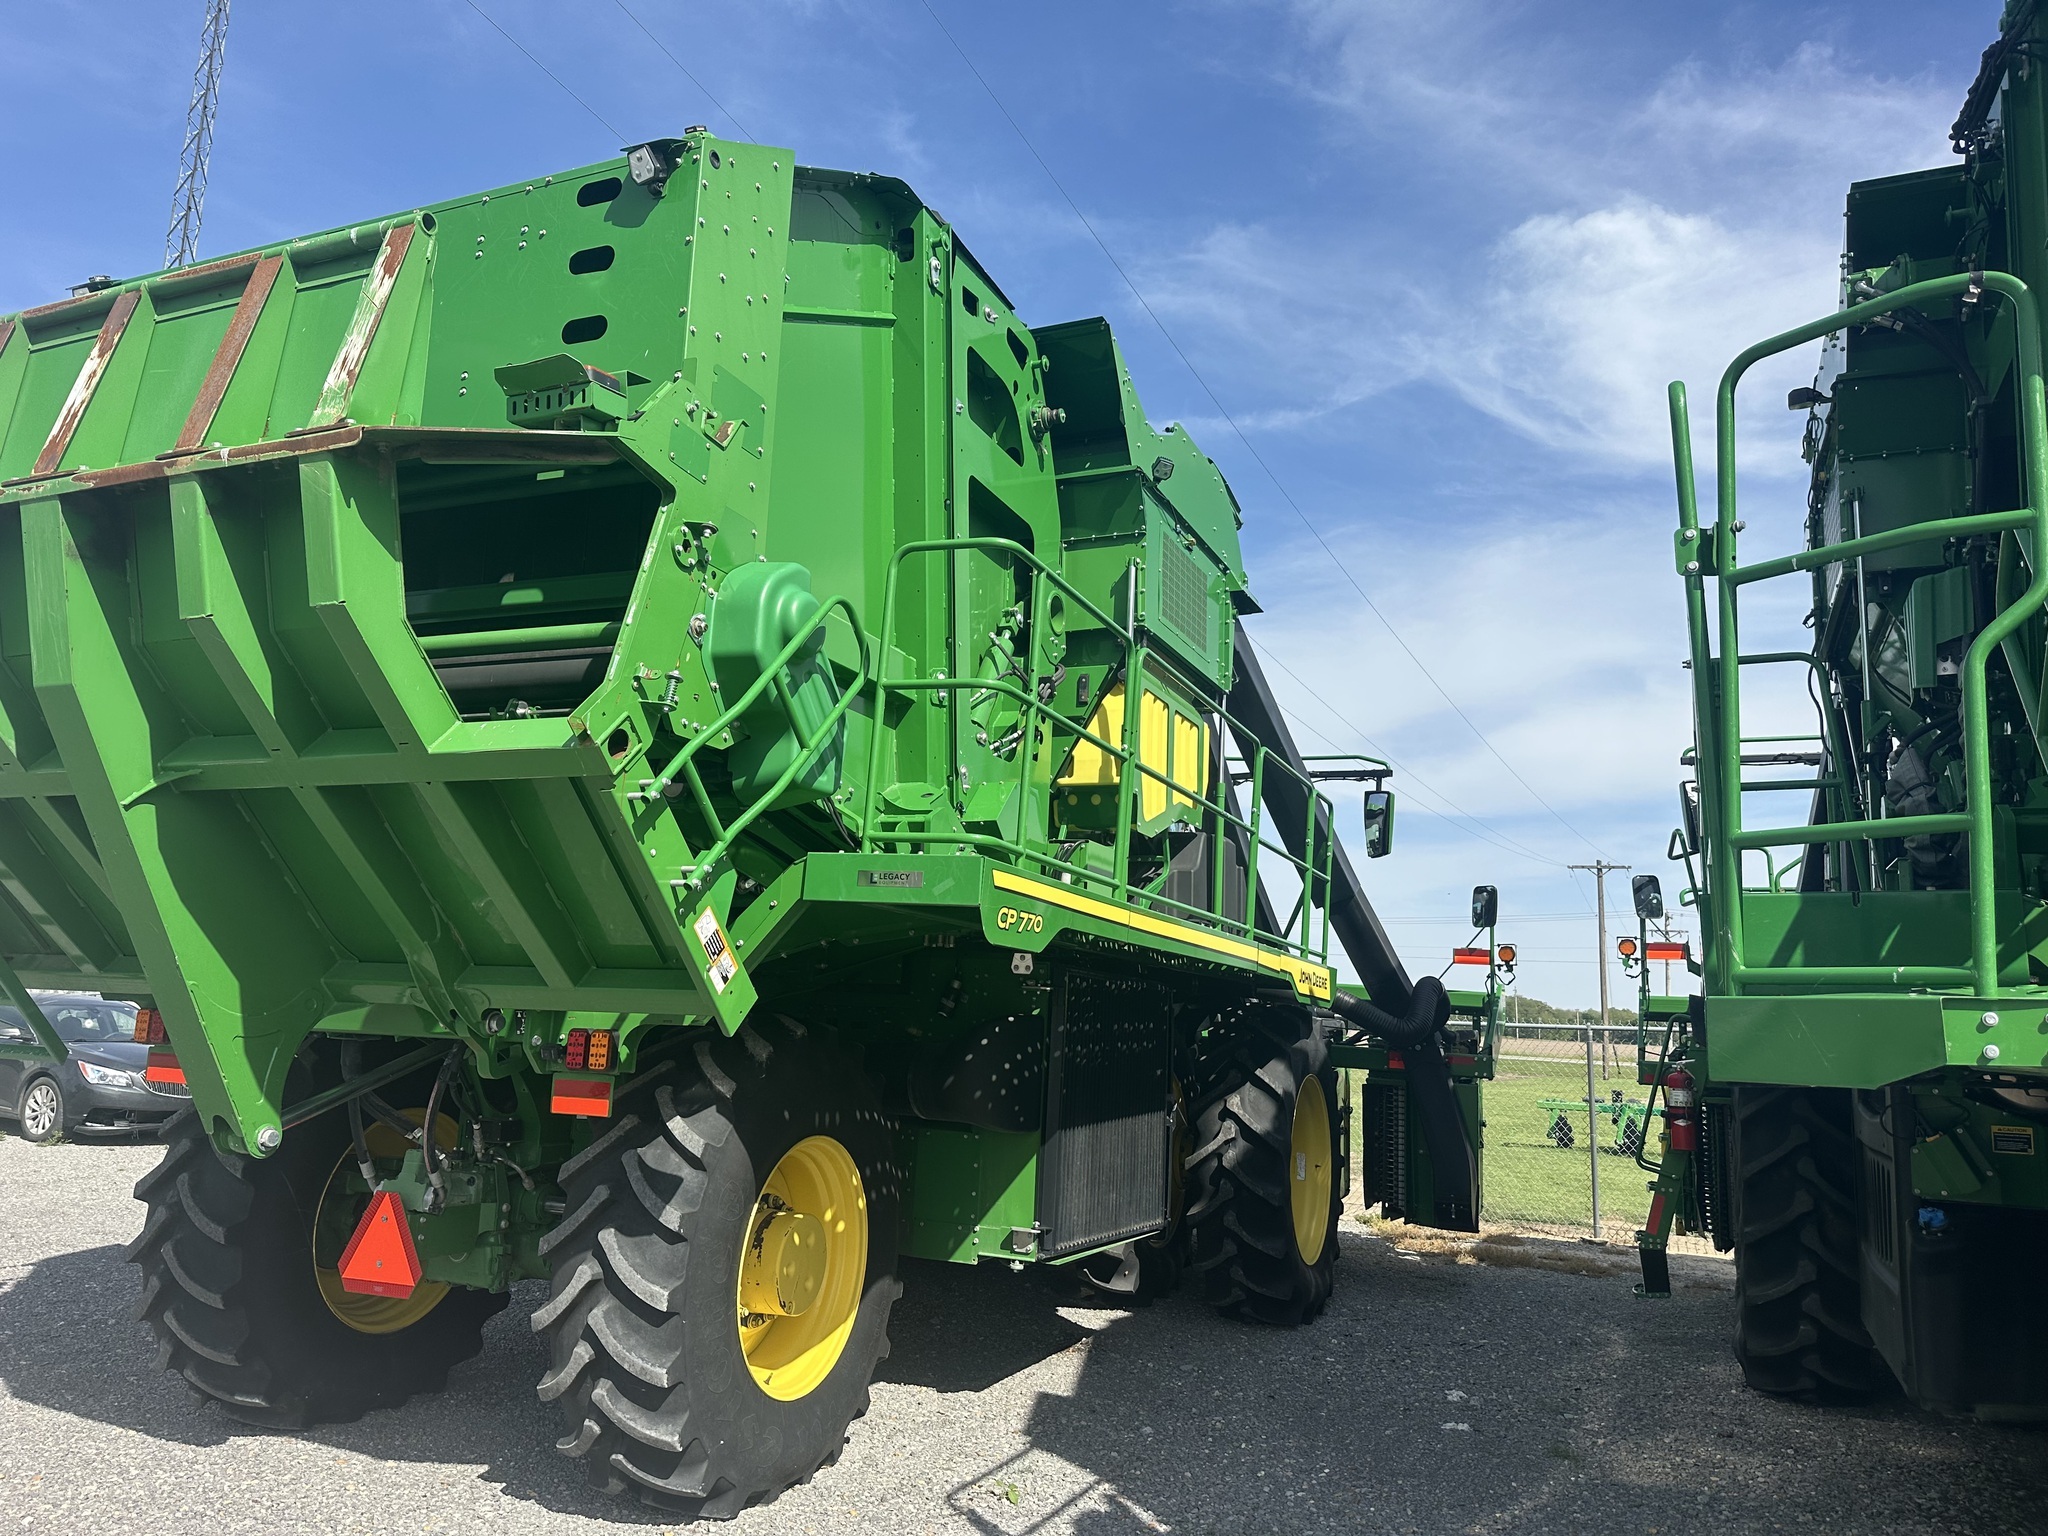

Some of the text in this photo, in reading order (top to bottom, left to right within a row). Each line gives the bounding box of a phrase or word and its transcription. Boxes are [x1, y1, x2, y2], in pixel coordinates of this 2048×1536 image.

[997, 906, 1043, 933] CP 770
[1299, 968, 1328, 990] JOHN DEERE
